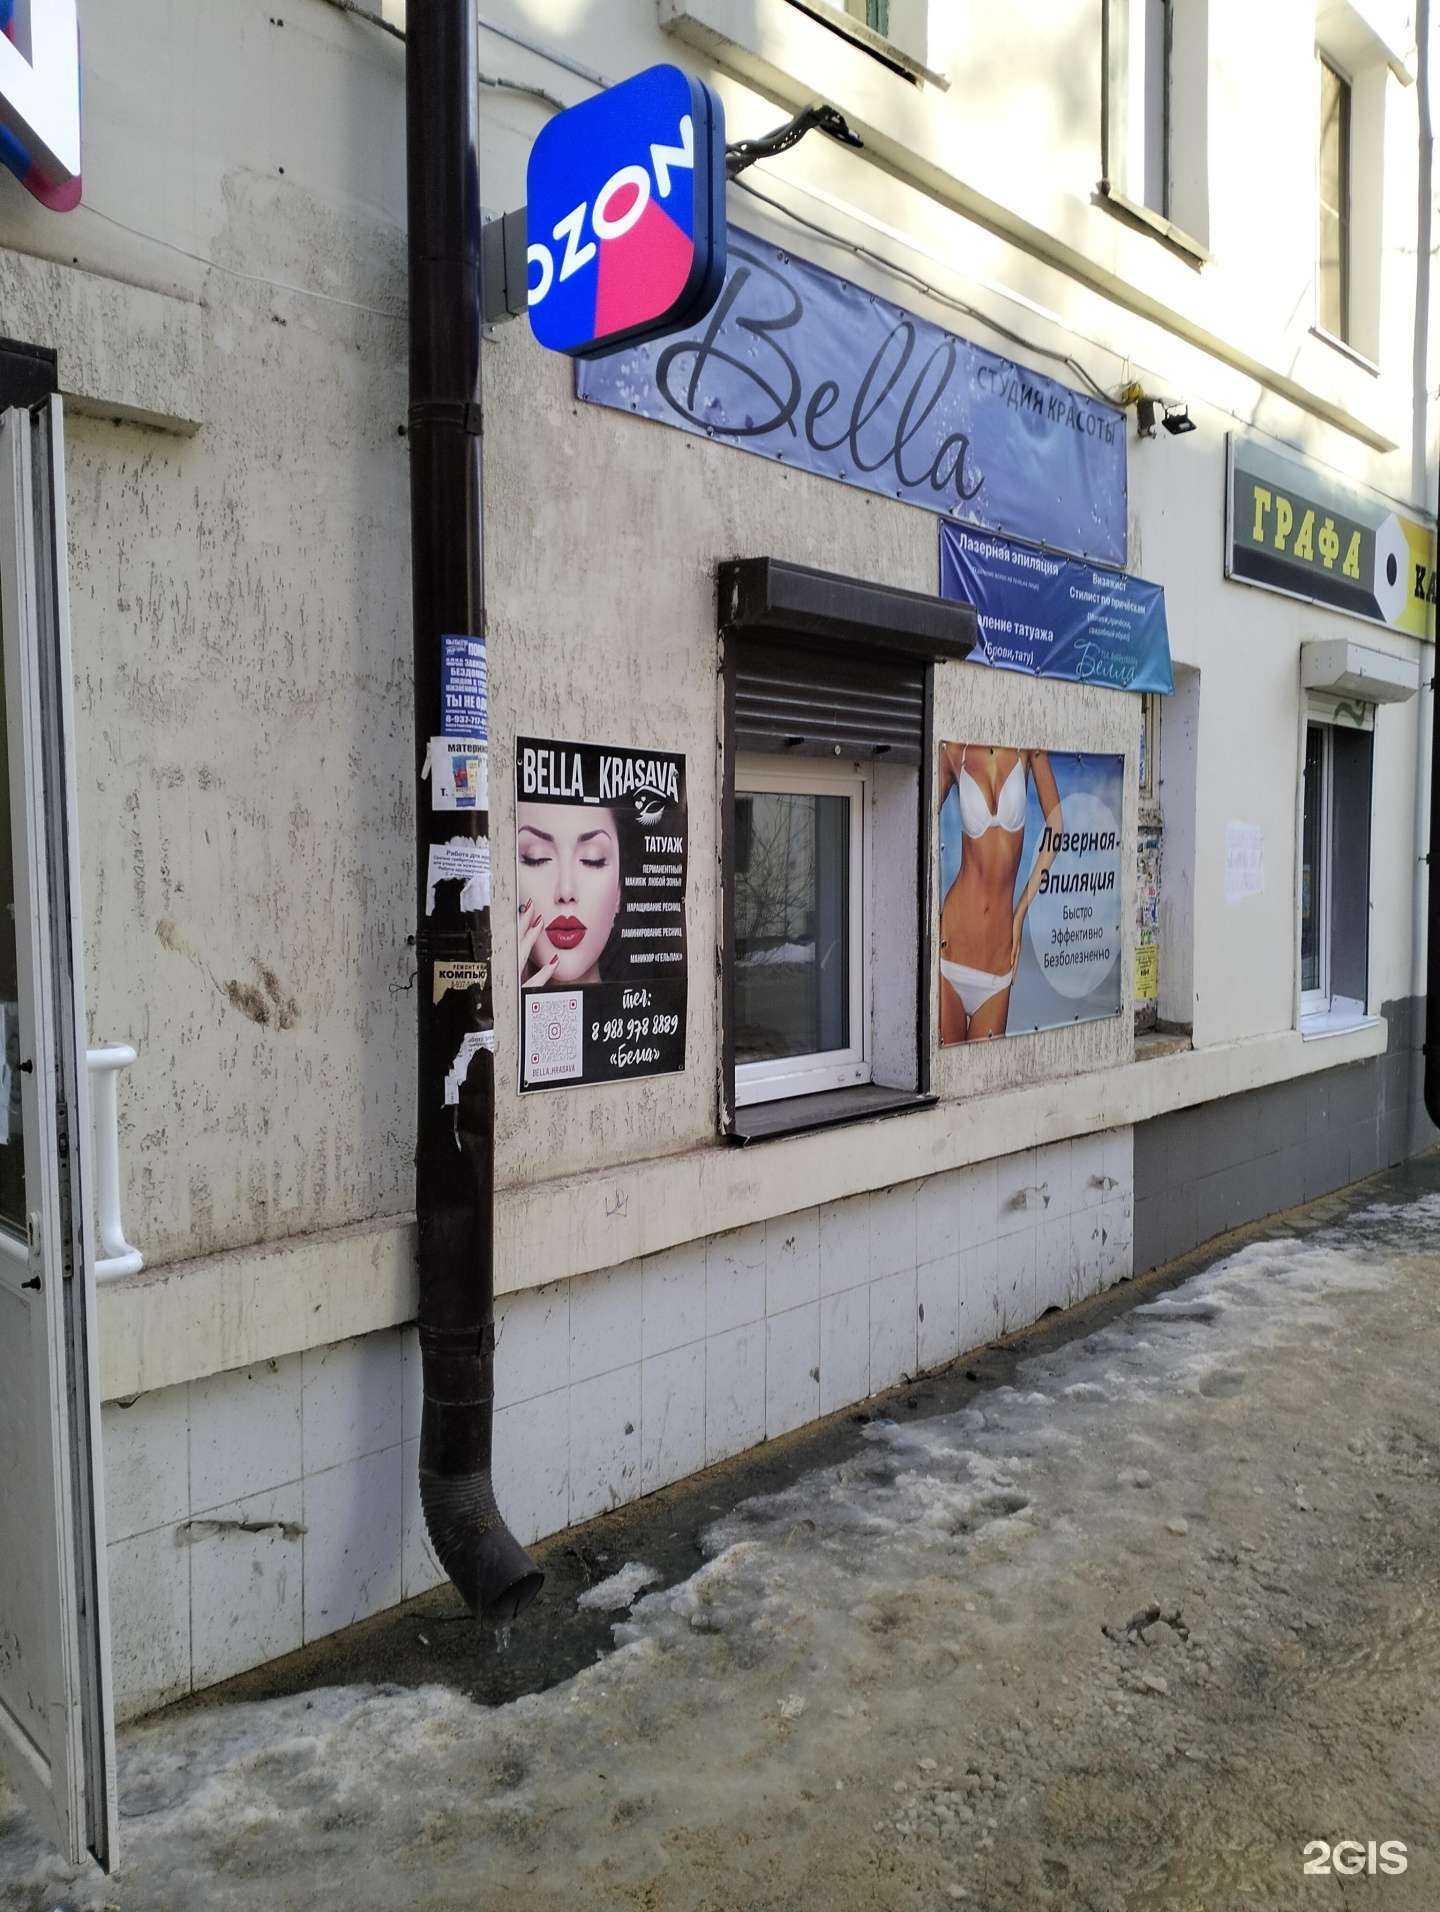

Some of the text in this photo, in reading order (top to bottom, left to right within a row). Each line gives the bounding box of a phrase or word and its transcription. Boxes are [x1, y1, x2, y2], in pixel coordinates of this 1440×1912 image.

[527, 115, 694, 306] OZON
[656, 247, 985, 501] Bella
[977, 366, 1116, 446] СТУДИЯ КРАСОТЫ
[1252, 485, 1361, 580] ГРАФА
[959, 533, 1059, 576] Лазерная эпиляция
[1092, 573, 1126, 592] Визажист
[1070, 586, 1100, 604] Стилист
[1101, 596, 1111, 606] по
[1013, 622, 1053, 642] татуажа
[446, 694, 462, 707] ТЫ
[464, 695, 475, 708] НЕ
[523, 748, 679, 804] BELLA_KRASAVA
[644, 836, 683, 854] ТАТУАЖ
[1039, 827, 1115, 857] Лазерная
[643, 864, 683, 874] ПЕРМАНЕНТНЫЙ
[625, 877, 646, 887] МАКИЯЖ
[648, 876, 665, 887] ЛЮБОЙ
[1038, 868, 1115, 895] Эпиляция
[627, 903, 681, 913] НАРАЩИВАНИЕ РЕСНИЦ
[1063, 905, 1093, 922] Быстро
[621, 928, 682, 938] ЛАМИНИРОВАНИЕ РЕСНИЦ
[1051, 927, 1103, 946] Эффективно
[630, 954, 654, 963] МАНИКЮР
[1043, 948, 1110, 968] Безболезненно
[592, 1022, 599, 1040] 8
[603, 1019, 623, 1042] 988
[627, 1017, 649, 1043] 978
